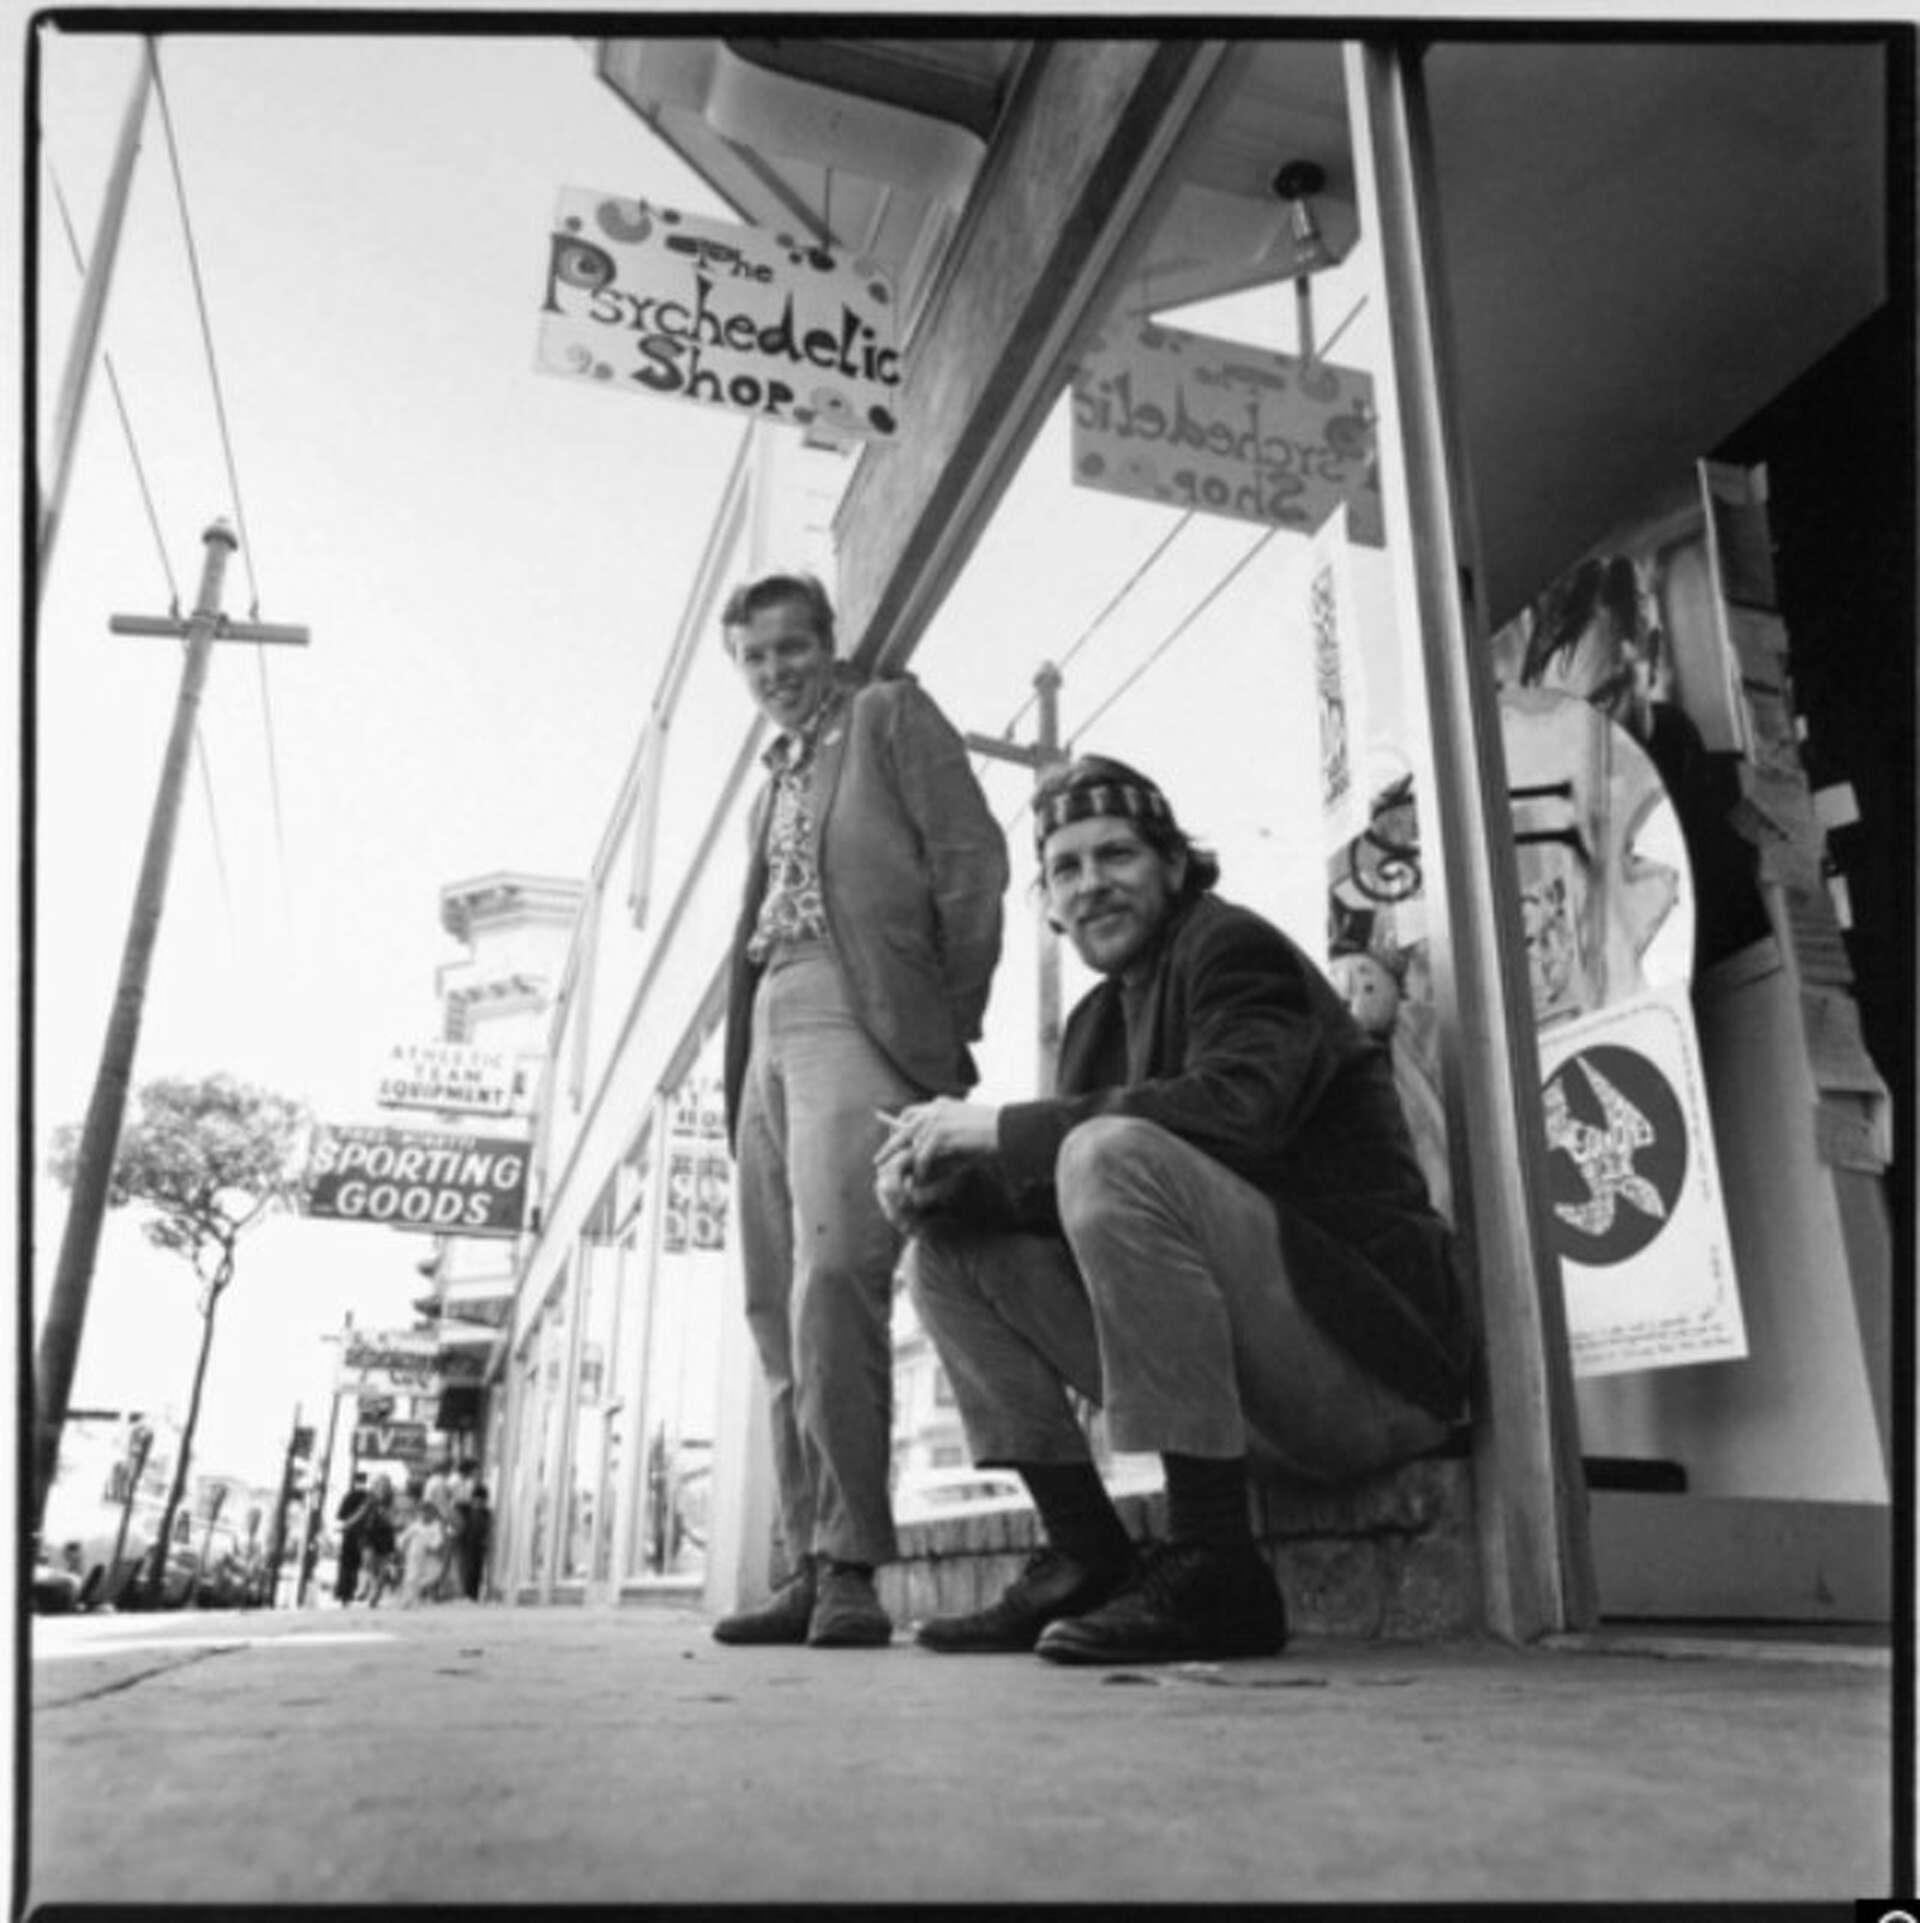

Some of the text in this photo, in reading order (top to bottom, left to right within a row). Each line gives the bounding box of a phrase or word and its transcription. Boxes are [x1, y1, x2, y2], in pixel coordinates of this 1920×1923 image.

[665, 234, 774, 284] The
[541, 232, 901, 386] Psychedelic
[631, 334, 796, 415] Shop
[312, 1140, 524, 1190] SPORTING
[336, 1181, 493, 1225] GOODS
